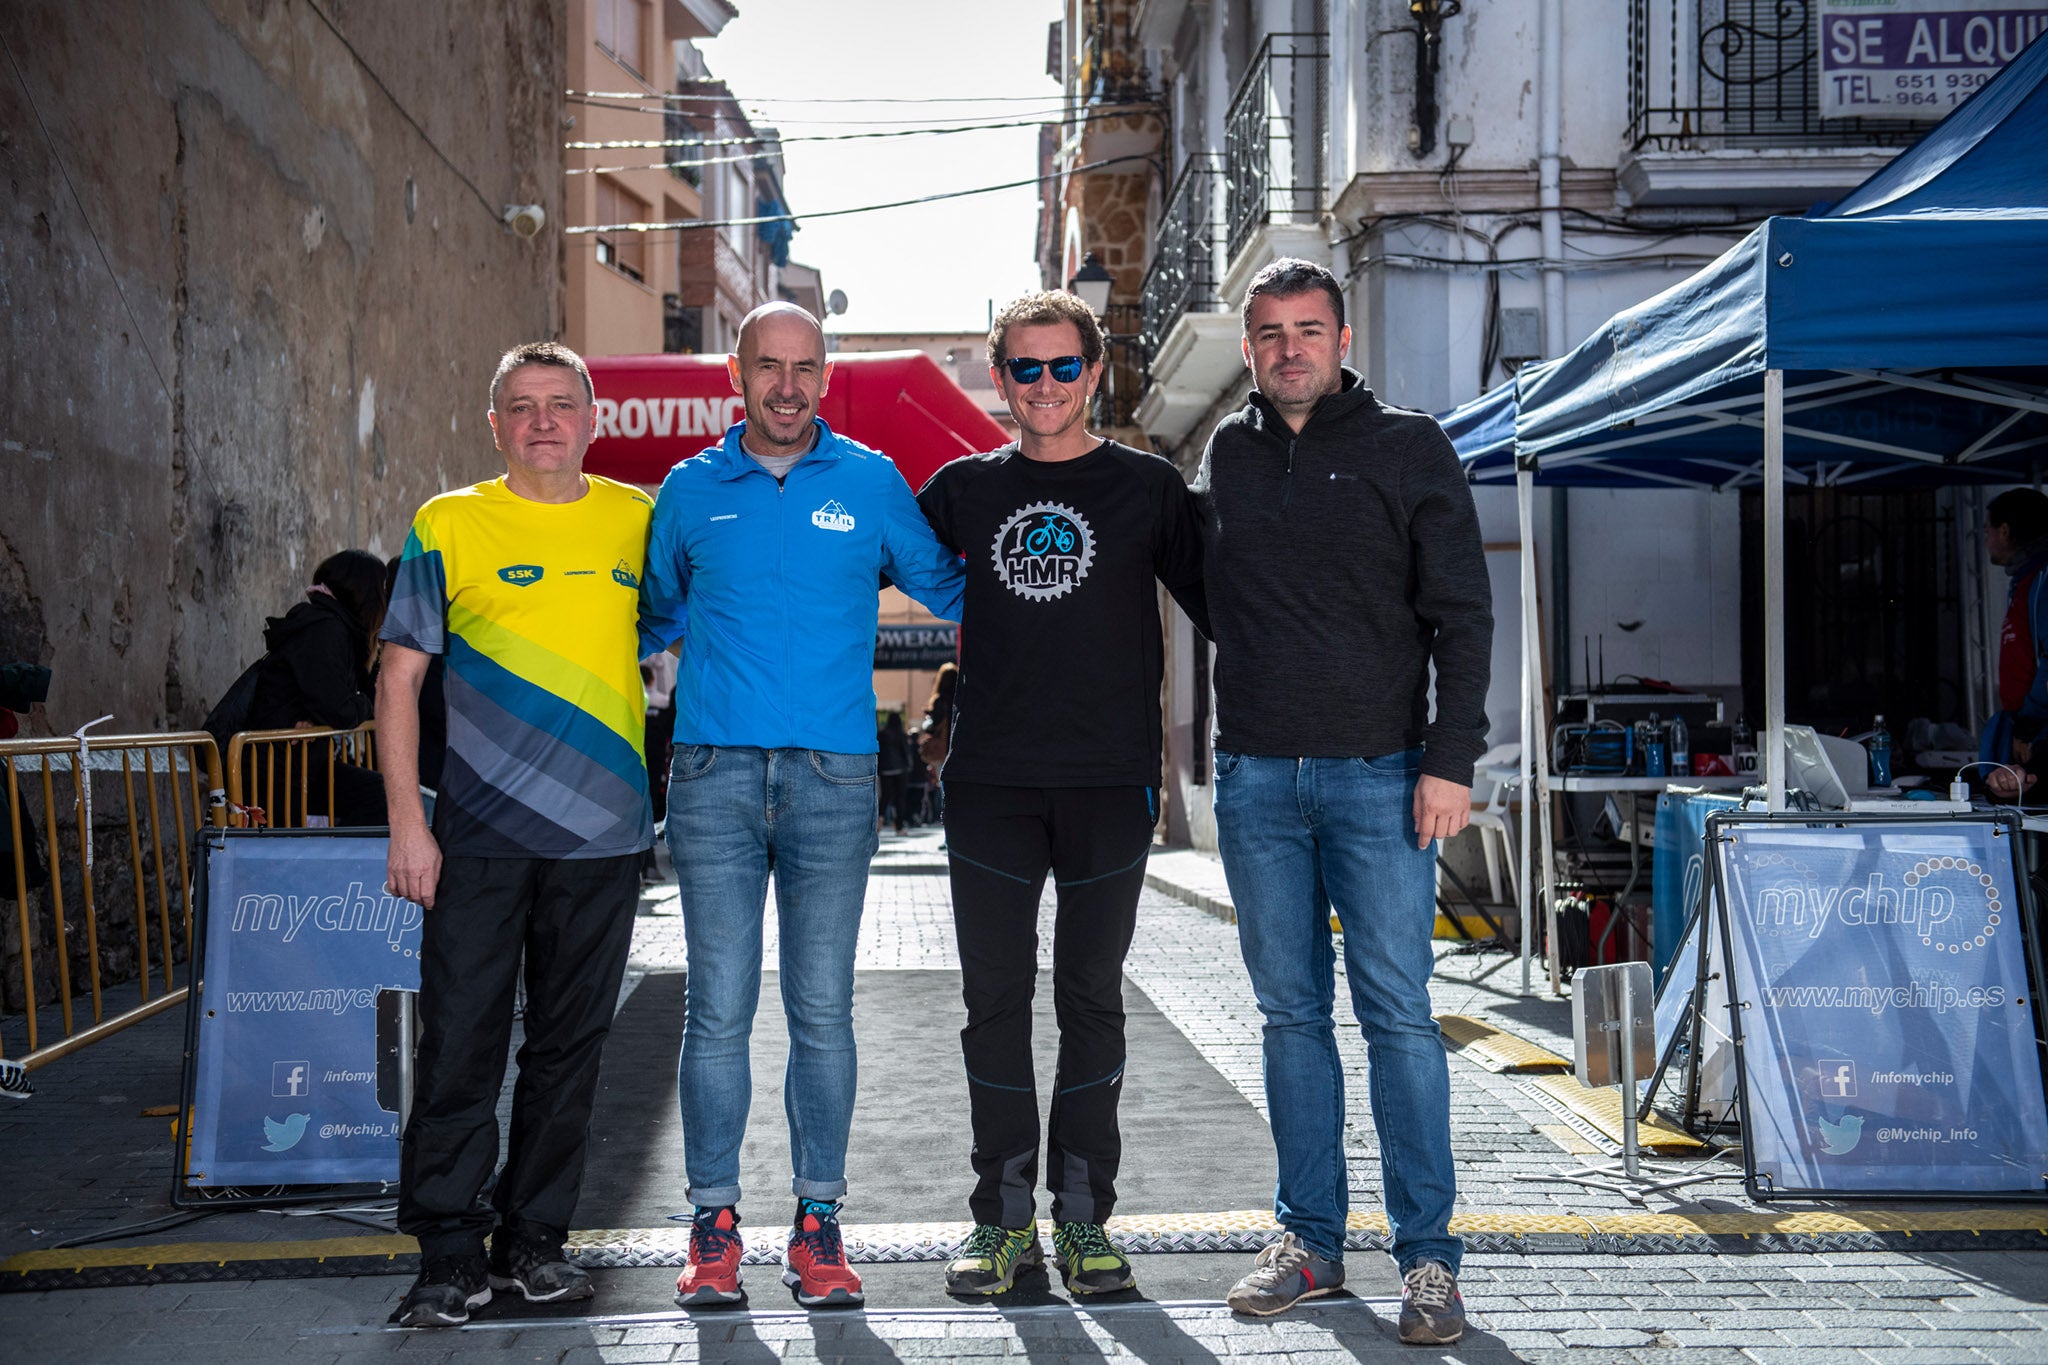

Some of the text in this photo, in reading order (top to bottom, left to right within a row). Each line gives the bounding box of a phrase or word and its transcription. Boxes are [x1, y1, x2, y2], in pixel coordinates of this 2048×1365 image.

[1831, 19, 1884, 64] SE
[1896, 75, 1936, 89] 651
[1946, 73, 1988, 88] 930
[1896, 92, 1938, 105] 964
[815, 514, 853, 526] TRAIL
[1007, 555, 1081, 588] HMR
[231, 882, 424, 943] mychip
[1756, 873, 1955, 938] mychip
[1761, 981, 2005, 1014] www.mychip.es
[323, 1070, 377, 1084] /infomy
[1871, 1071, 1954, 1086] /infomychip
[1876, 1127, 1978, 1143] @Mychip_Info
